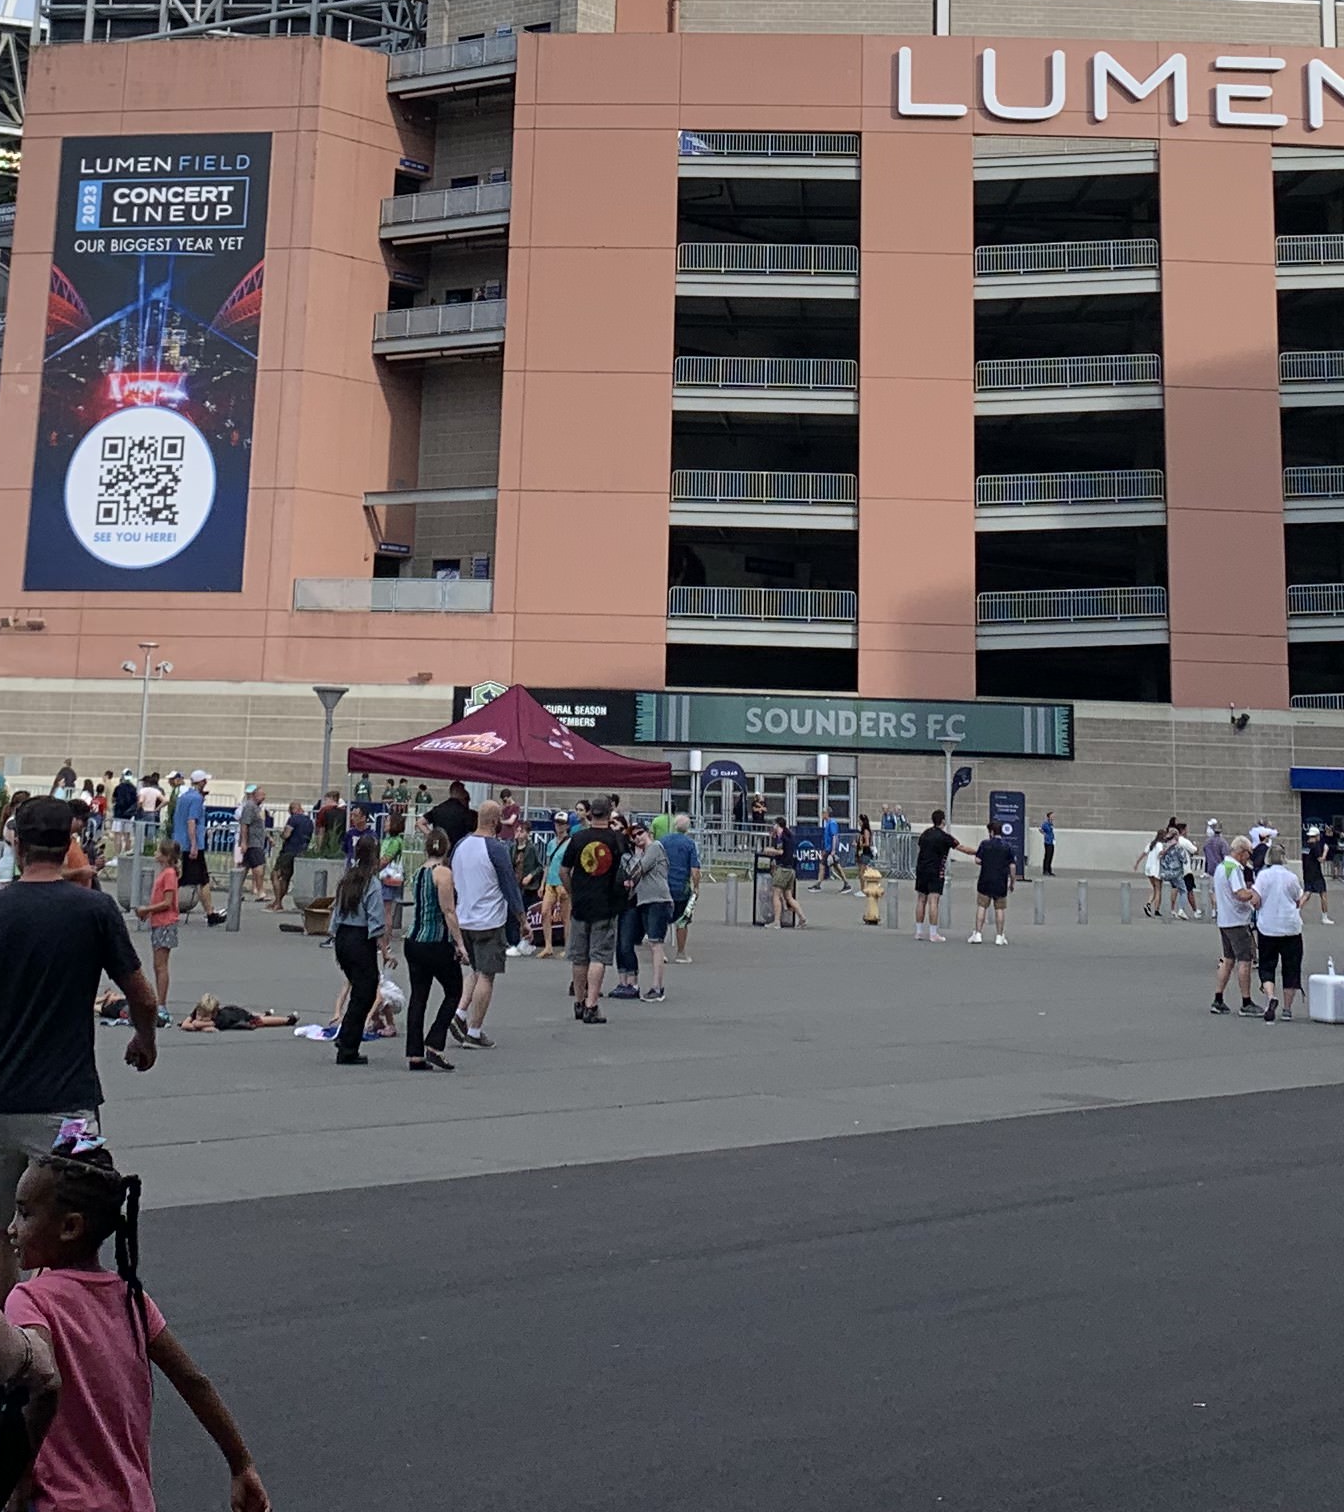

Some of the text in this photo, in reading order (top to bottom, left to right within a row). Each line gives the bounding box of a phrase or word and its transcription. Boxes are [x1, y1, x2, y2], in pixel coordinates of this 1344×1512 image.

[80, 154, 251, 174] LUMEN FIELD
[82, 185, 98, 224] 2023
[112, 186, 234, 205] CONCERT
[112, 205, 233, 223] LINEUP
[74, 237, 244, 253] OUR BIGGEST YEAR YET
[93, 531, 177, 542] SEE YOU HERE!
[574, 705, 607, 716] SEASON
[745, 707, 967, 739] SOUNDERS FC
